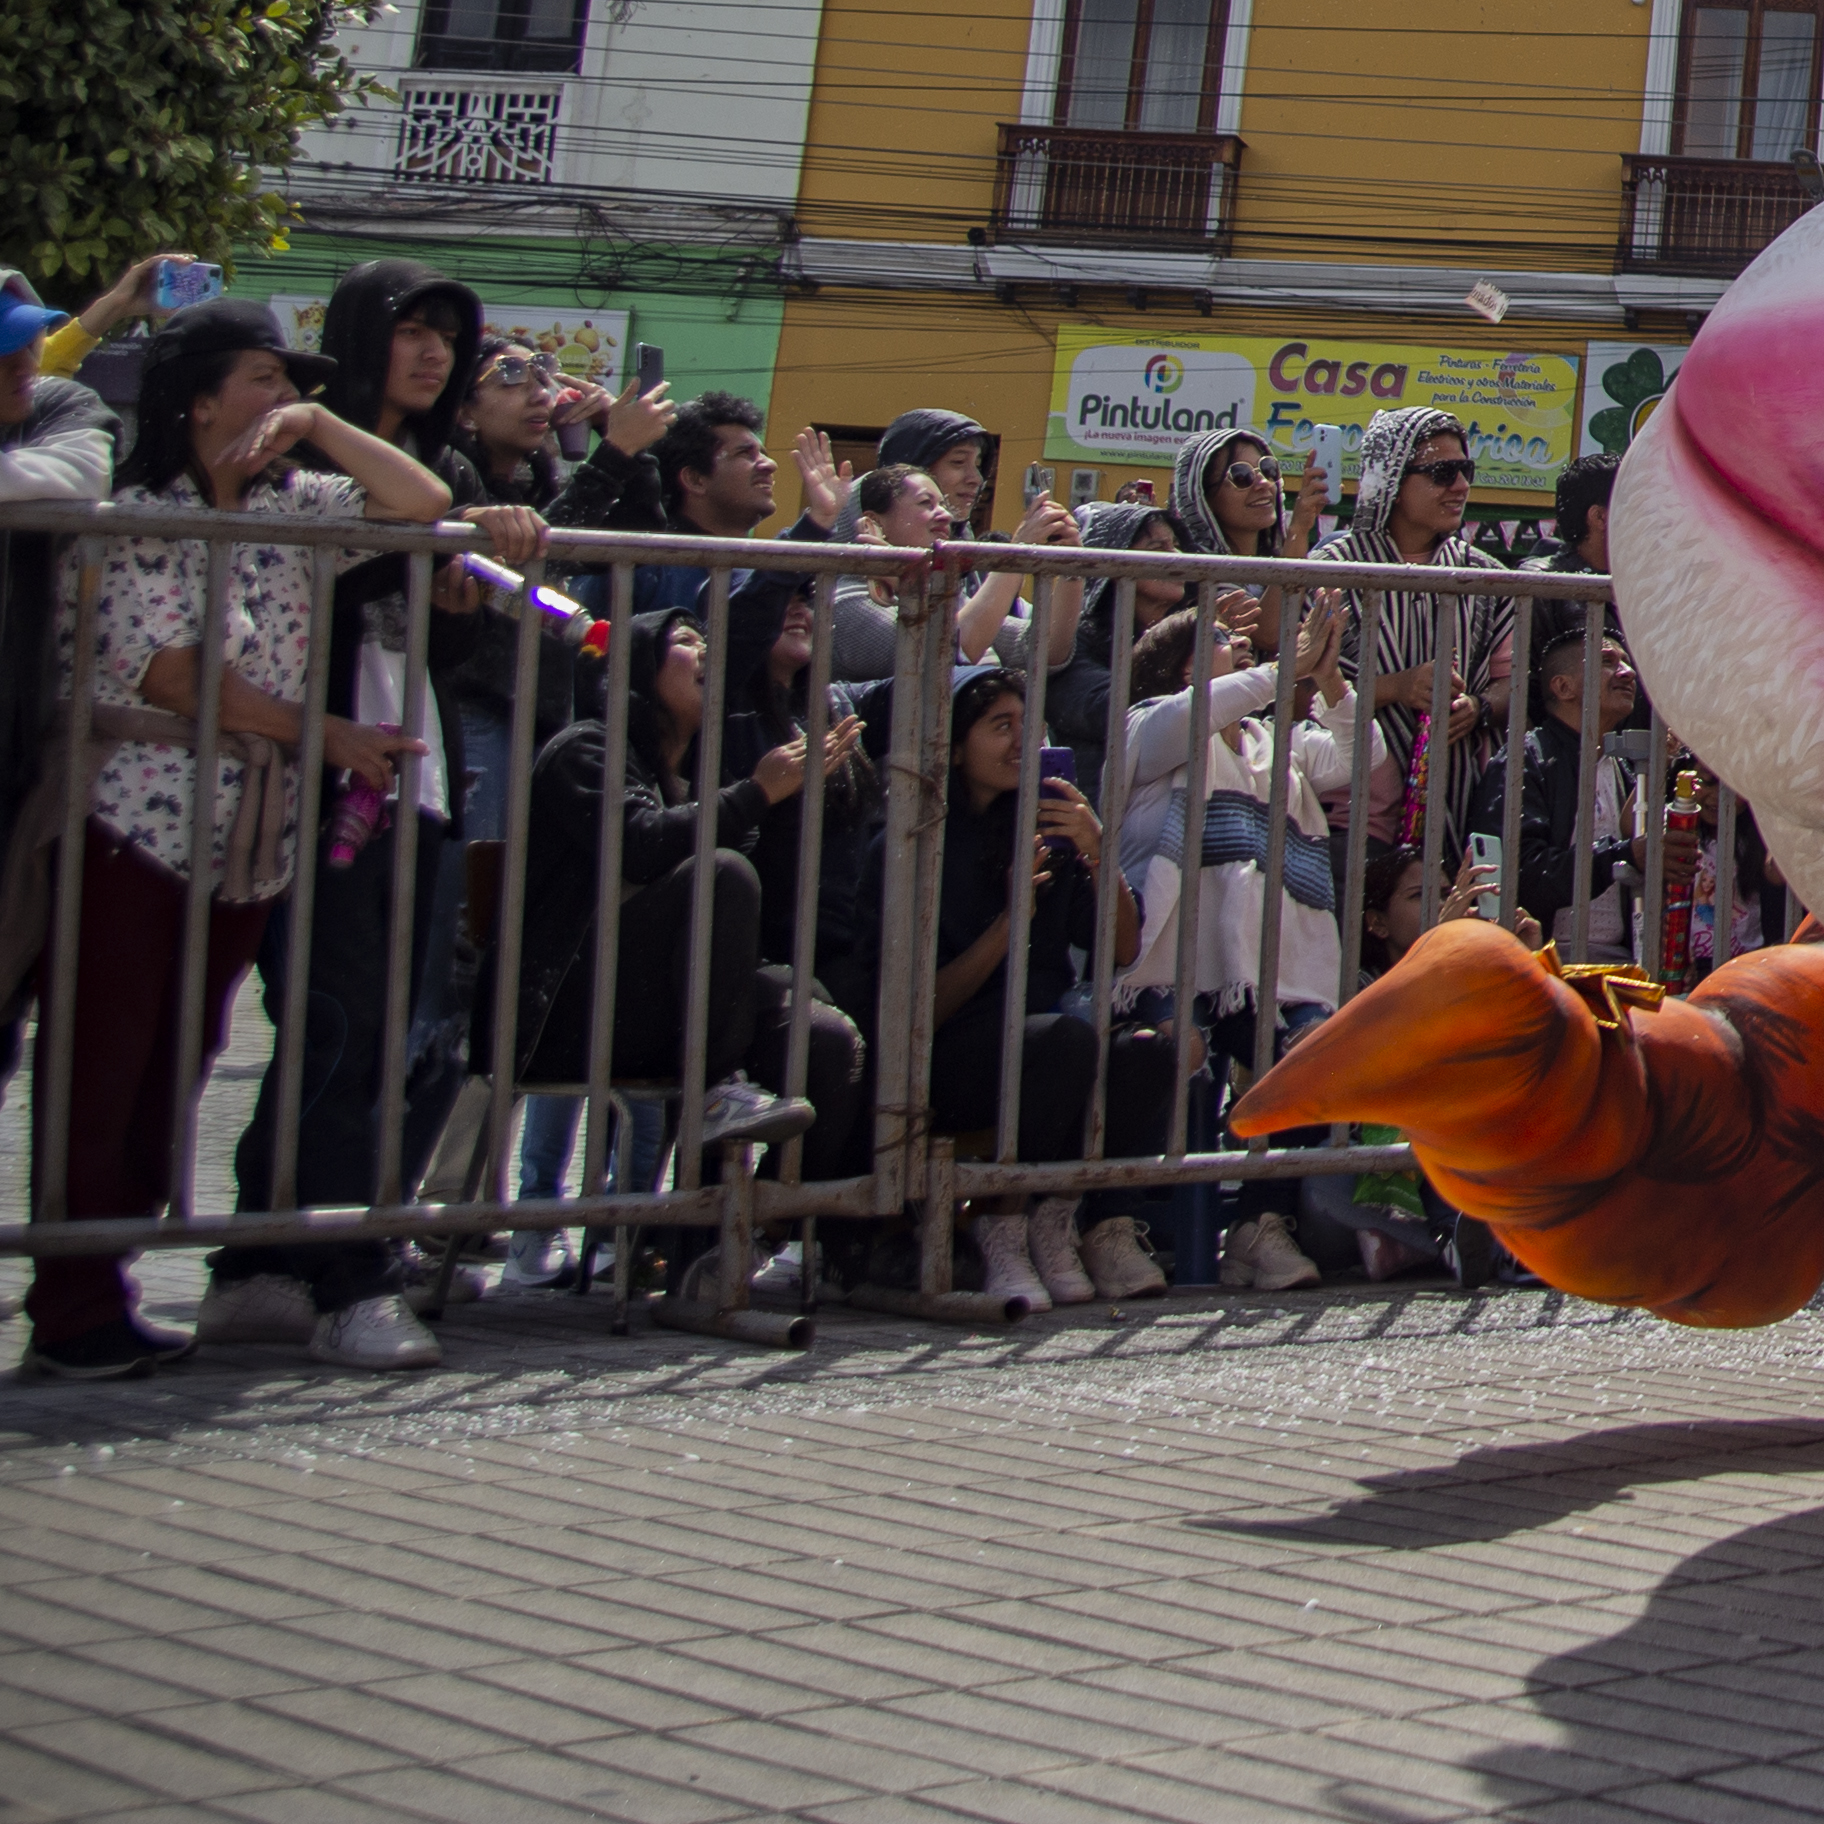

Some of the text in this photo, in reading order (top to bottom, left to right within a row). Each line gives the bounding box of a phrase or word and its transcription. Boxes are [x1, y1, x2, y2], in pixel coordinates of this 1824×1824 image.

[1439, 354, 1482, 369] Pinturas
[1268, 342, 1409, 399] Casa
[1466, 378, 1475, 390] y
[1476, 377, 1500, 387] otros
[1502, 376, 1556, 392] Materiales
[1431, 392, 1457, 405] para
[1459, 389, 1470, 403] la
[1079, 393, 1239, 432] Pintuland
[1101, 432, 1132, 441] nueva
[1134, 432, 1172, 445] imagen
